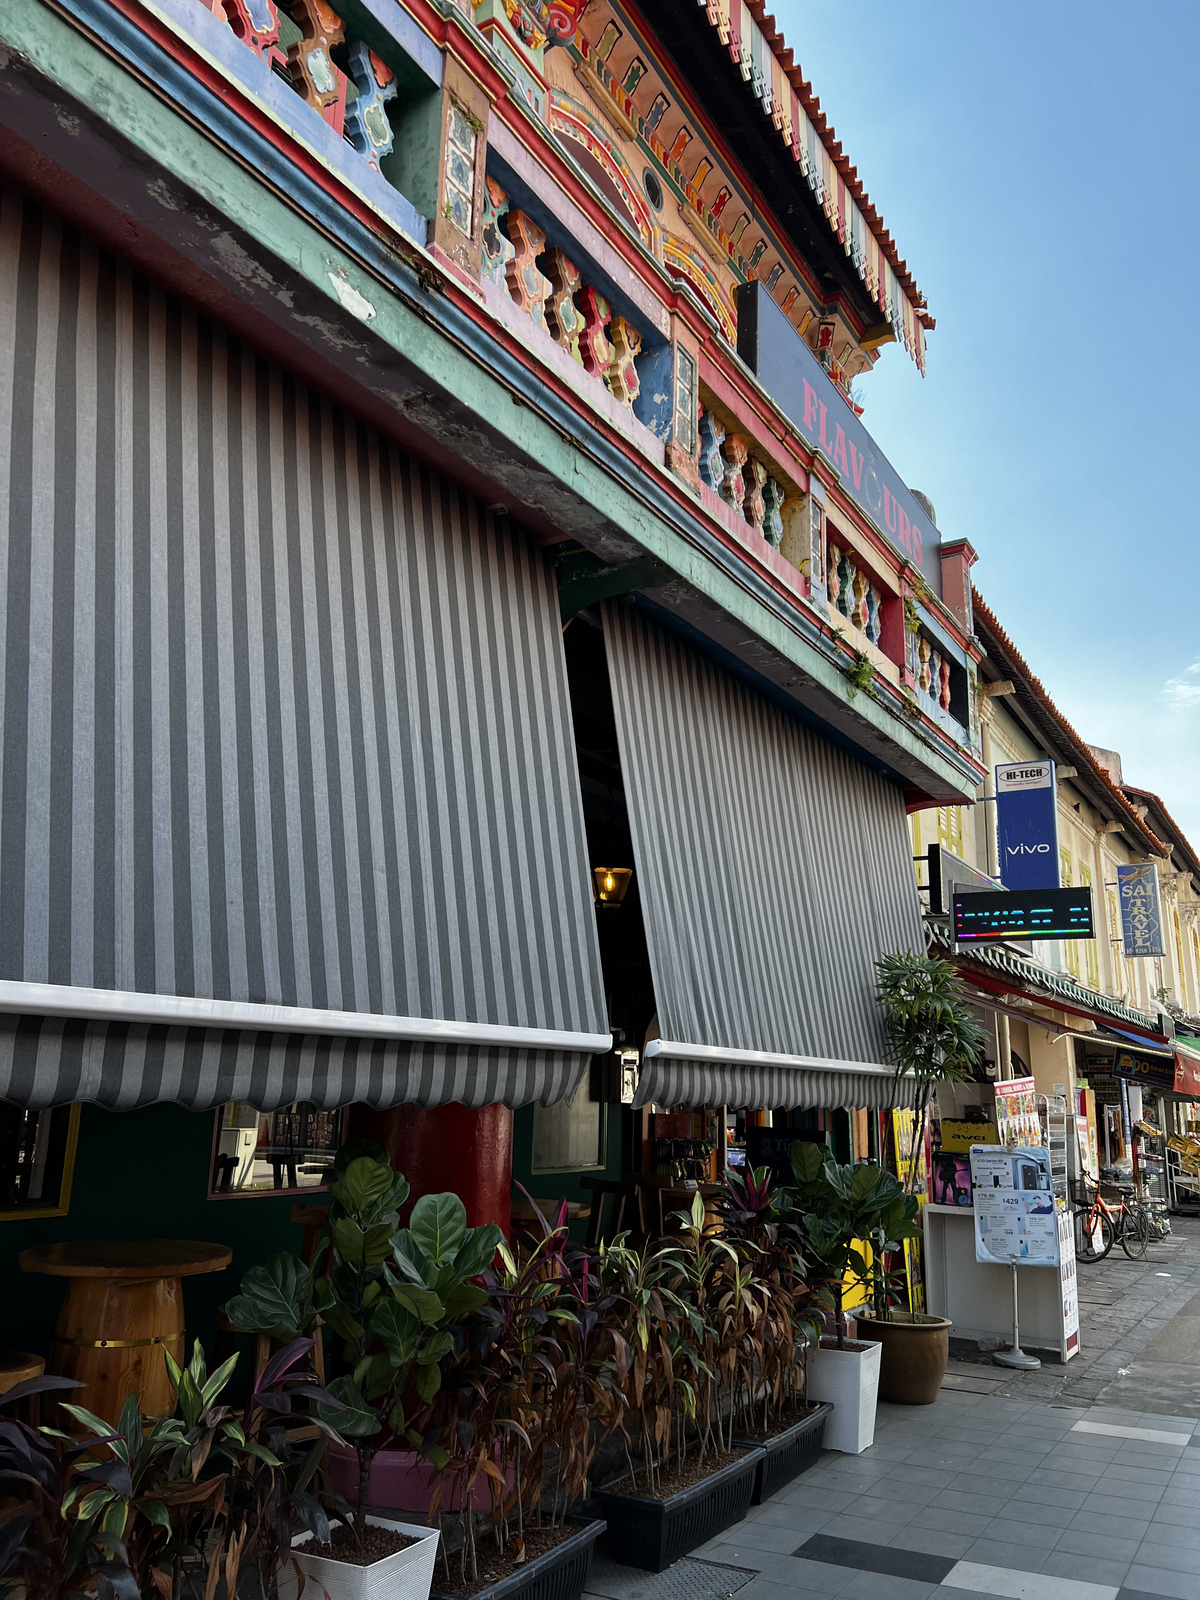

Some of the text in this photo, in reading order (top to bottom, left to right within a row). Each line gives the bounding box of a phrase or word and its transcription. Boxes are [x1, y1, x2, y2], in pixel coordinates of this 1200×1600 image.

[1006, 768, 1043, 780] HI-TECH
[1007, 843, 1050, 855] vivo
[1122, 883, 1155, 897] SAI
[1131, 898, 1151, 947] TRAVEL
